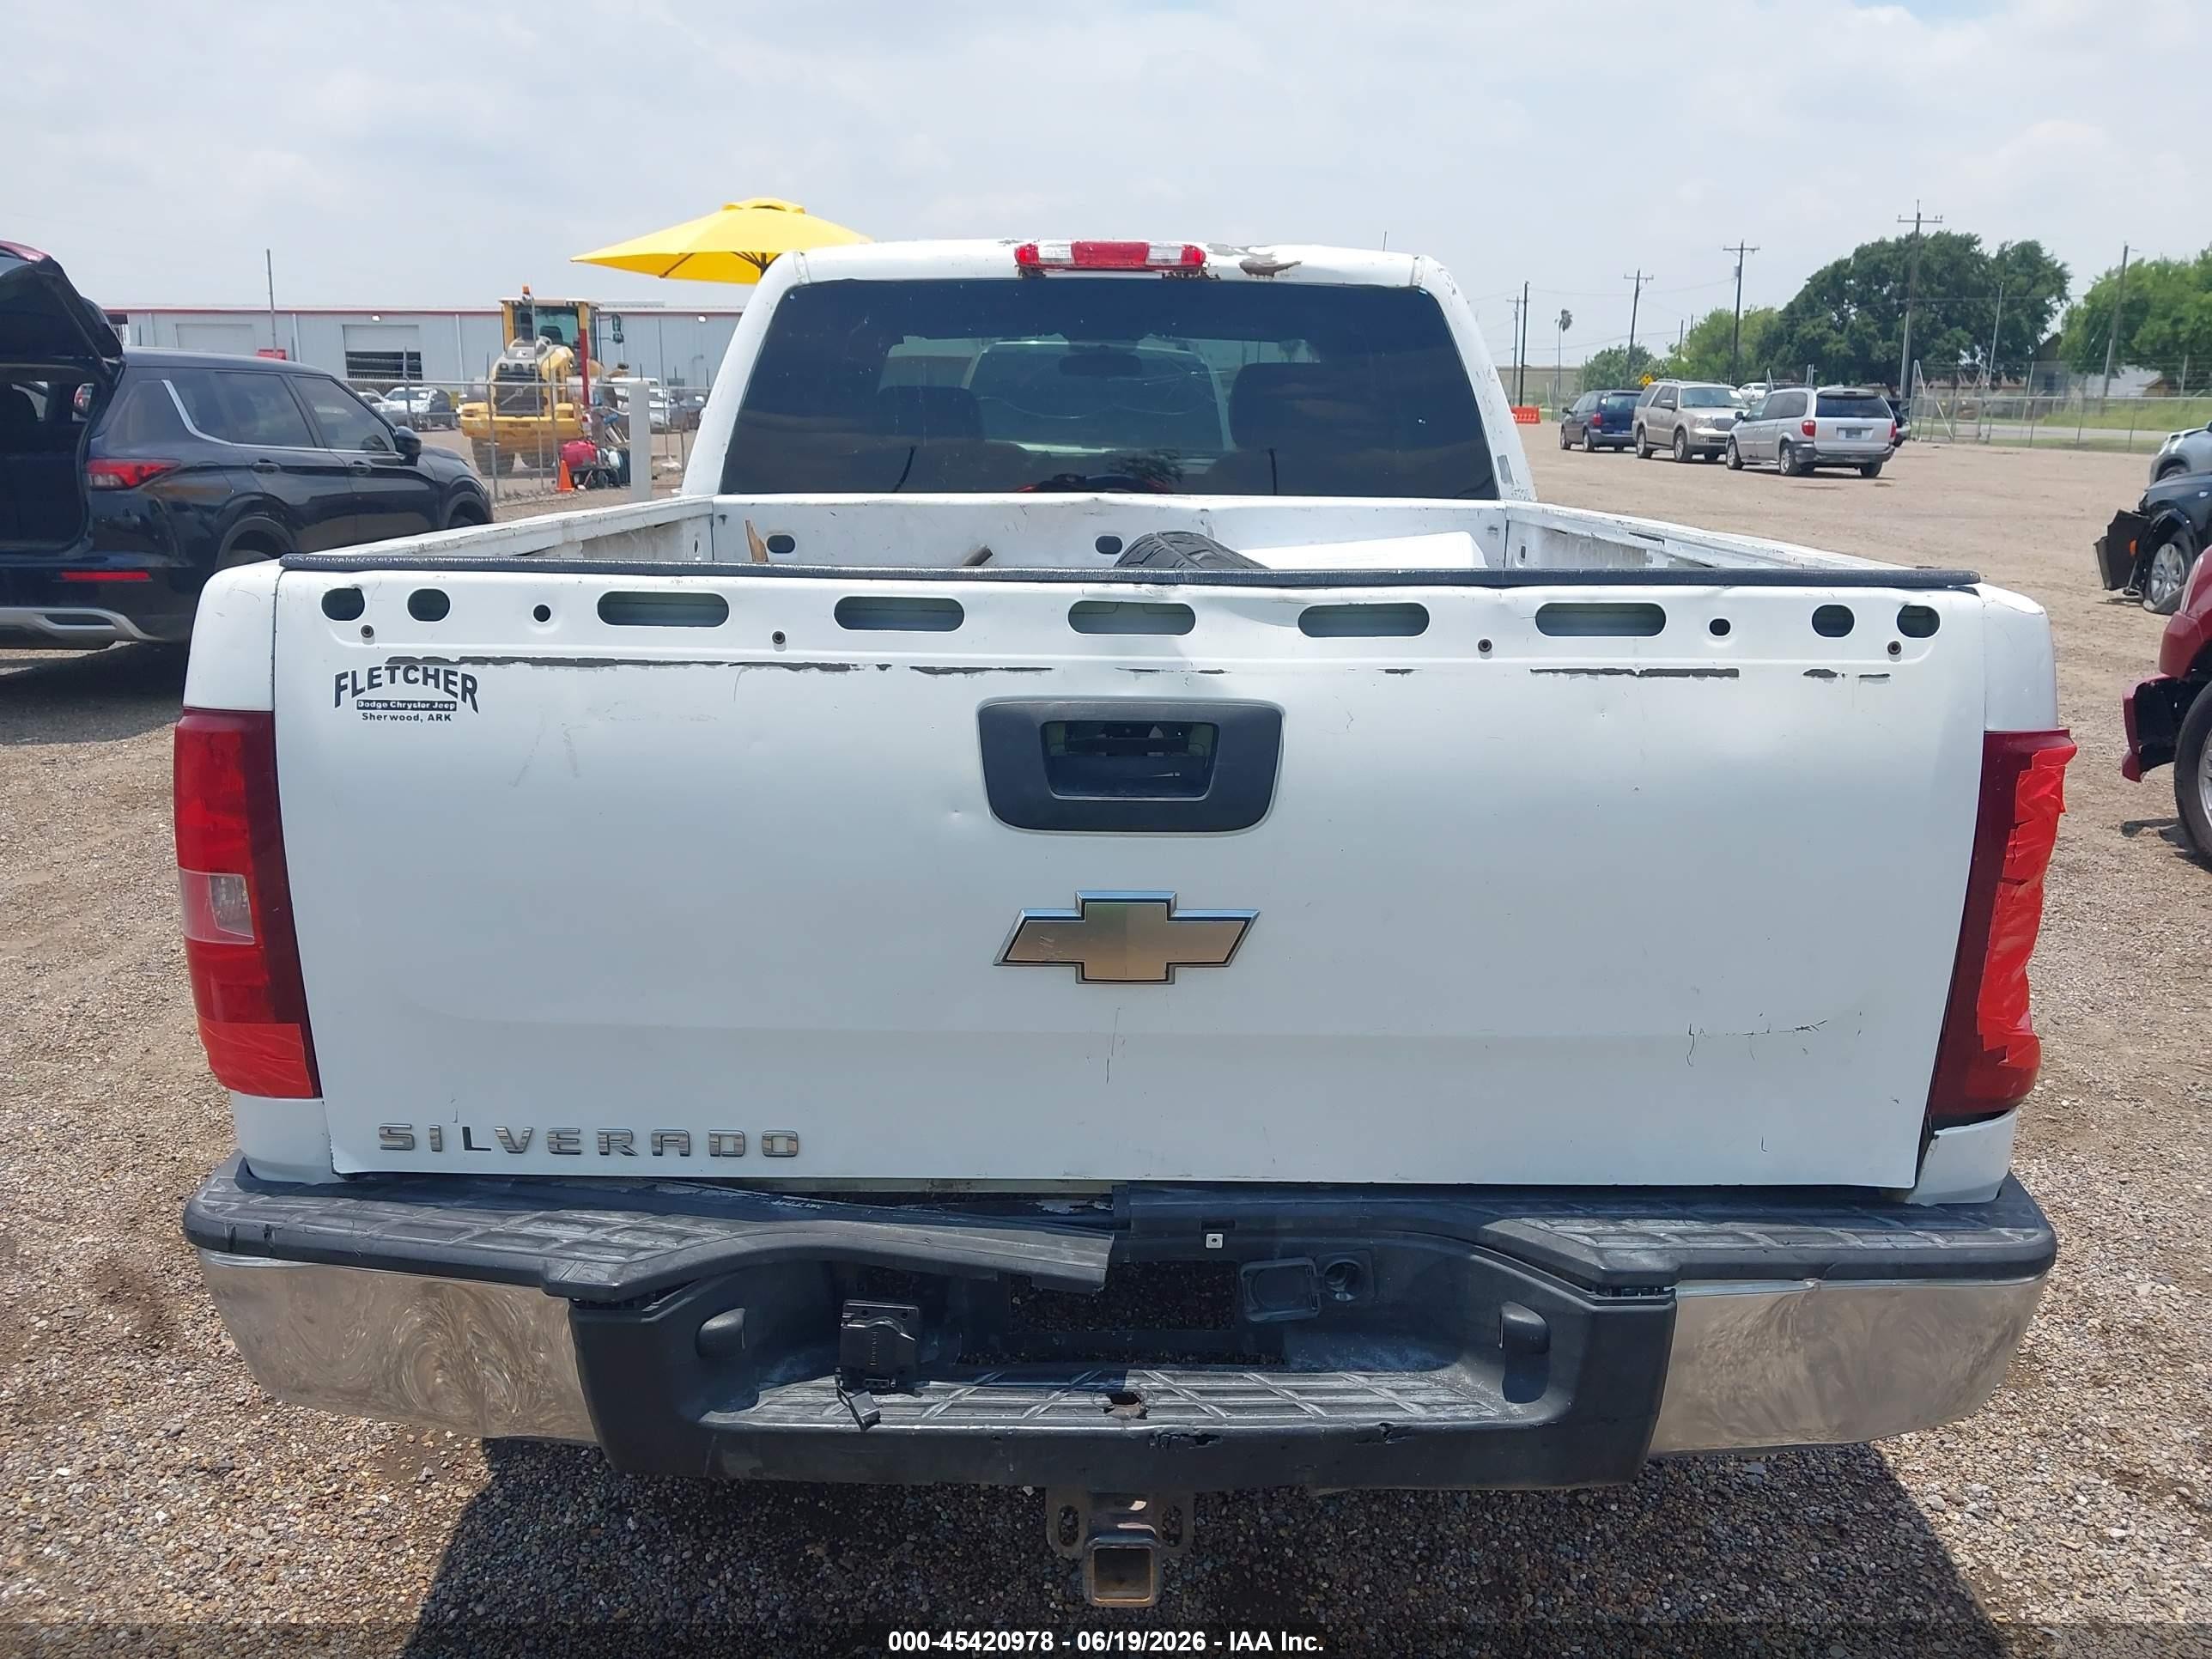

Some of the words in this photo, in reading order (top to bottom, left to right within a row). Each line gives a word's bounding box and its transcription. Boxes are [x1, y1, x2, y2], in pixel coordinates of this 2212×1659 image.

[334, 665, 479, 714] FLETCHER
[357, 700, 388, 709] Dodge
[390, 701, 430, 710] Chrysler
[432, 702, 456, 711] Jeep
[362, 712, 423, 723] Sherwood,
[427, 714, 452, 722] ARK
[378, 1122, 799, 1158] SILVERADO
